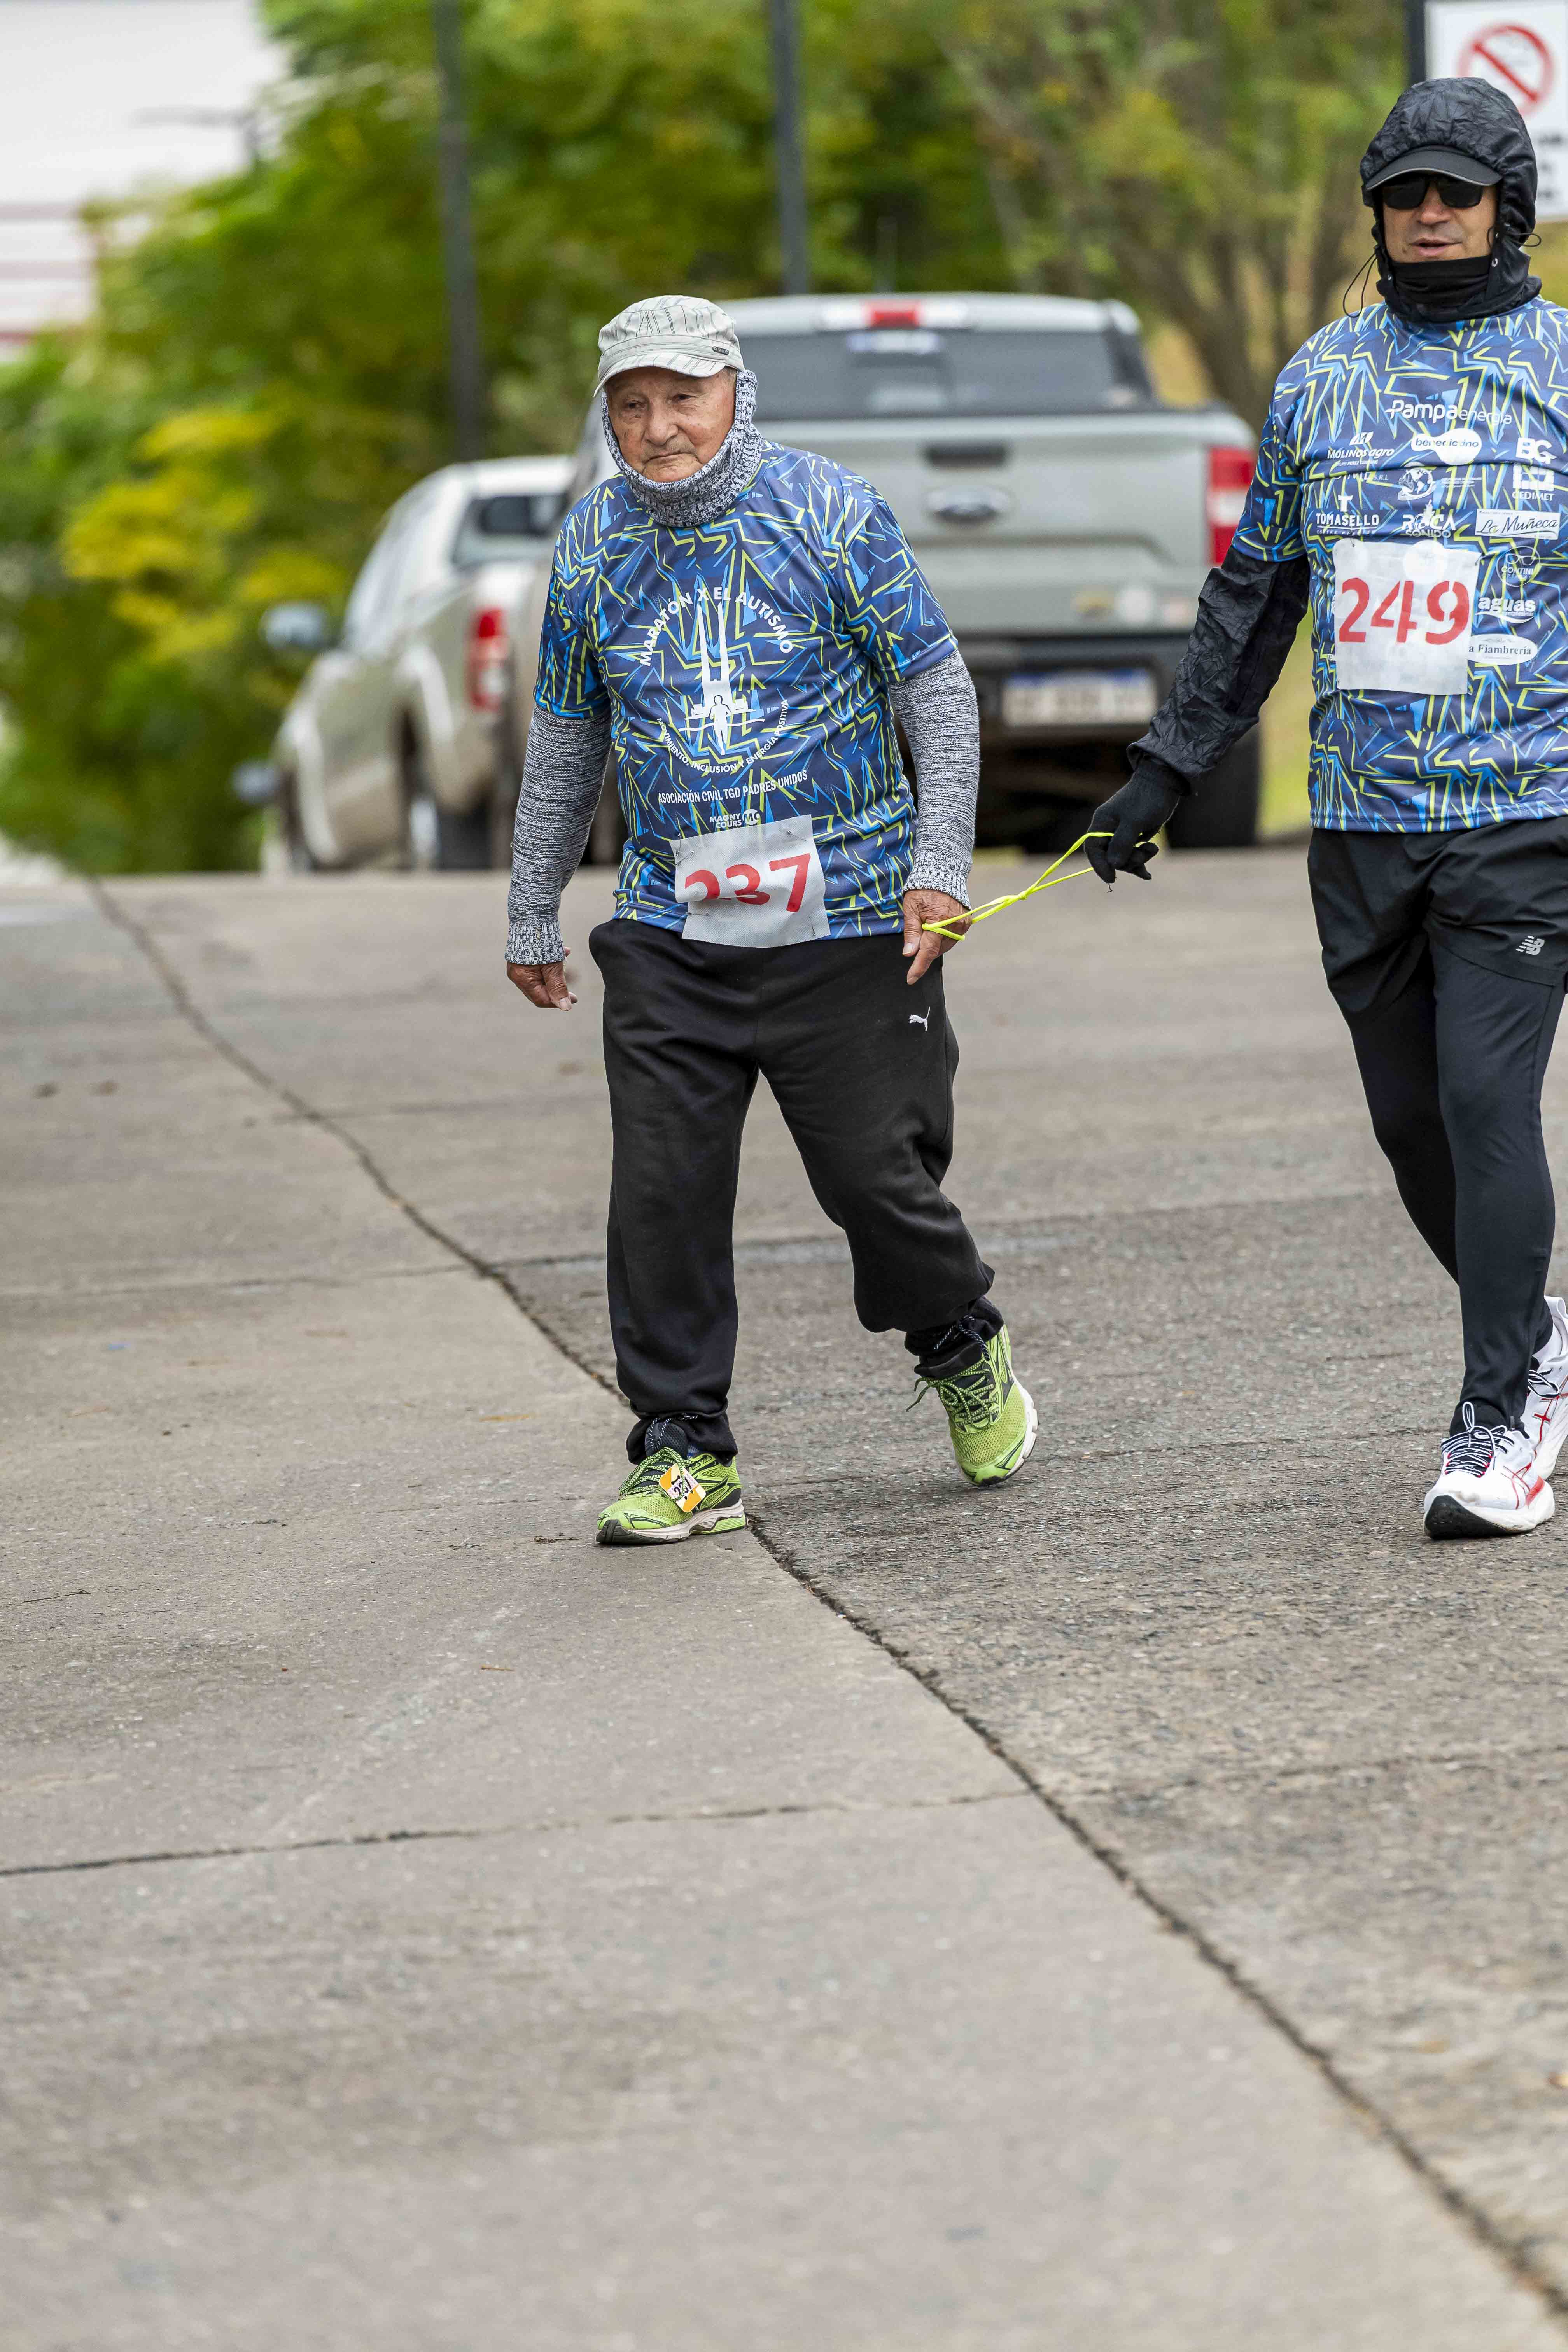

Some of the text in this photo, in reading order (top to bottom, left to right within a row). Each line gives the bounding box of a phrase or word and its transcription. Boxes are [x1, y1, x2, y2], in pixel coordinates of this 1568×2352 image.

[1415, 438, 1479, 448] benedicino
[1327, 448, 1394, 459] MOLINOS agro
[1512, 491, 1556, 502] CEDIMET
[1316, 513, 1379, 526] TOMASELLO
[1477, 515, 1559, 534] La Muñeca
[1339, 577, 1470, 645] 249
[1478, 597, 1536, 613] aguas
[640, 587, 794, 667] MARATÓN X EL AUTISMO
[1478, 644, 1531, 655] Fiambrería
[657, 699, 789, 774] MOVIMIENTO, INCLUSIÓN Y ENERGÍA POSITIVA
[658, 770, 808, 803] ASOCIACIÓN CIVIL TGD PADRES UNIDOS
[709, 812, 741, 824] MAGNY
[715, 819, 742, 829] COURS
[685, 852, 811, 913] 237
